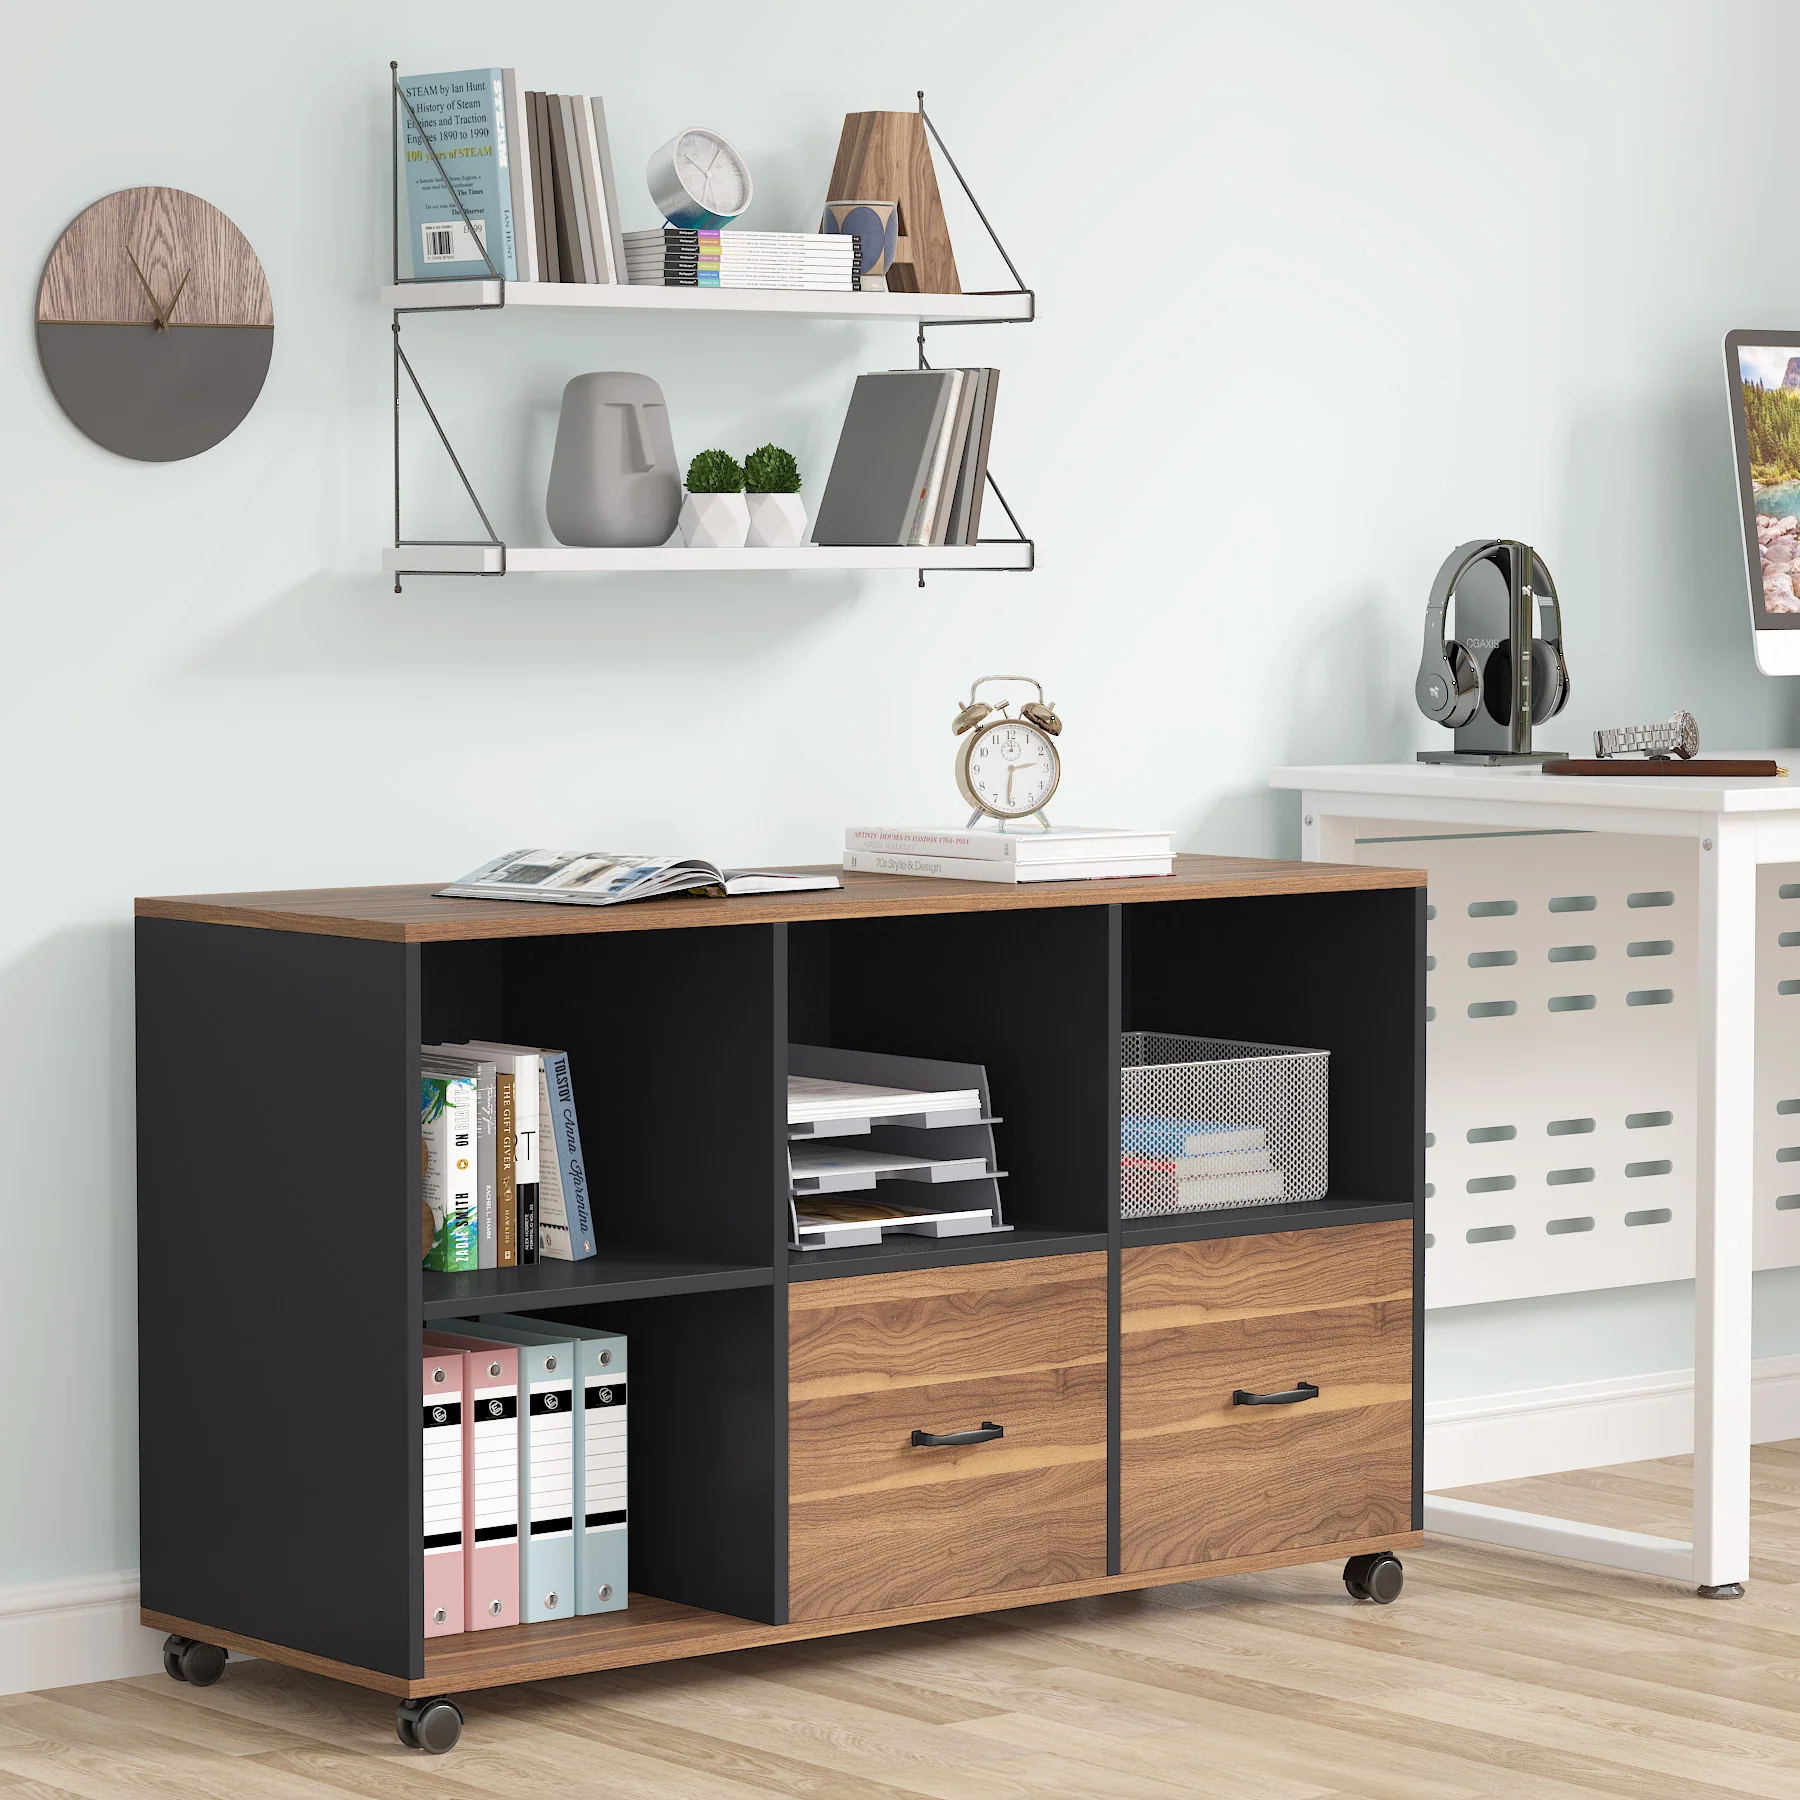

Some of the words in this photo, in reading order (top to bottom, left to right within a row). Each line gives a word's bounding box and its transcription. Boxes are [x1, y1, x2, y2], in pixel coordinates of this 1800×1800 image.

[406, 86, 438, 98] STEAM
[440, 84, 450, 97] by
[451, 83, 464, 94] Ian
[466, 81, 486, 92] Hunt
[416, 102, 445, 114] History
[446, 100, 456, 110] of
[456, 99, 481, 110] Steam
[406, 117, 437, 129] Eines
[439, 115, 453, 127] and
[454, 113, 487, 125] Traction
[493, 80, 508, 168] STEAM
[406, 133, 437, 146] Enges
[440, 130, 458, 142] 1890
[459, 131, 468, 140] to
[470, 128, 489, 138] 1990
[406, 150, 423, 162] 100
[448, 149, 457, 159] of
[458, 146, 493, 158] STEAM
[503, 209, 511, 228] IAN
[505, 231, 513, 260] HUNT
[1466, 638, 1500, 649] CGAXIS
[992, 735, 1000, 745] 11
[1006, 730, 1016, 740] 12
[979, 747, 989, 758] 10
[1037, 746, 1044, 756] 2
[973, 764, 981, 775] 9
[1043, 763, 1050, 774] 3
[979, 781, 986, 792] 8
[1037, 780, 1044, 790] 4
[993, 793, 998, 804] 7
[1008, 797, 1016, 808] 6
[1027, 792, 1034, 803] 5
[879, 833, 903, 841] HOUSES
[911, 835, 939, 843] LONDON
[876, 857, 888, 868] 70s
[888, 858, 907, 871] Style
[907, 859, 914, 870] &
[915, 860, 942, 873] Design
[554, 1058, 571, 1102] TOLSTOY
[503, 1083, 511, 1106] THE
[455, 1089, 470, 1131] BEAUTY
[503, 1109, 511, 1134] GIFT
[563, 1108, 577, 1155] Anna
[455, 1133, 469, 1147] ON
[503, 1136, 511, 1170] GIVER
[568, 1159, 588, 1234] Karenina
[455, 1192, 469, 1227] SMITH
[455, 1231, 469, 1262] ZADIE
